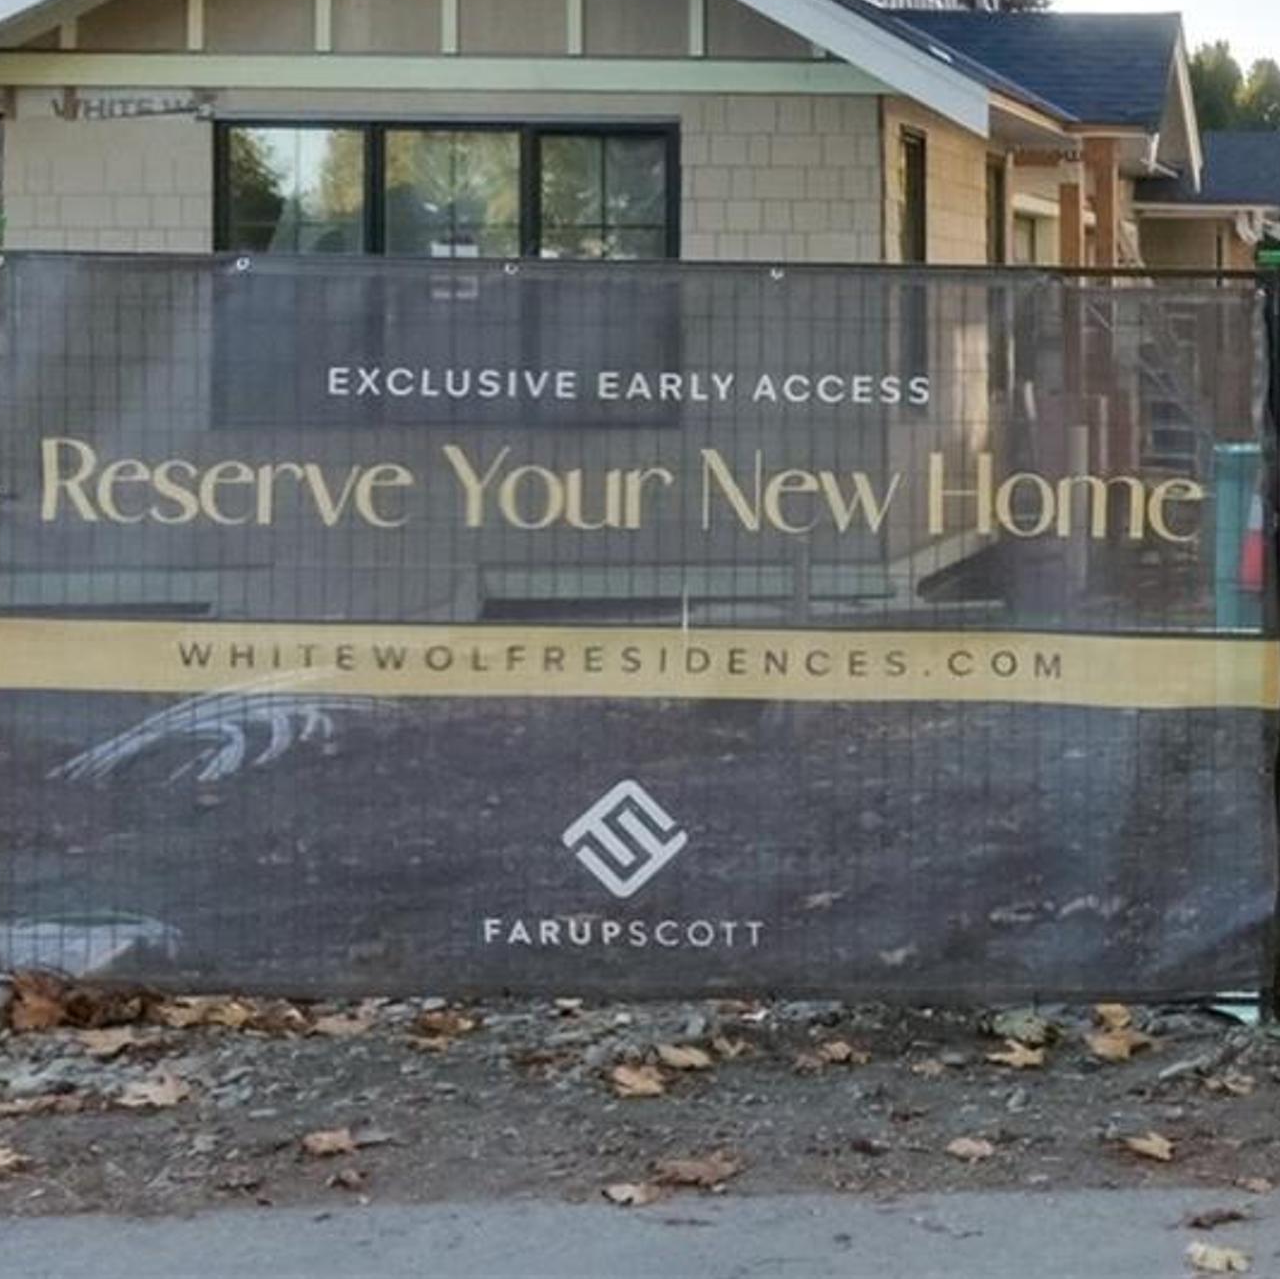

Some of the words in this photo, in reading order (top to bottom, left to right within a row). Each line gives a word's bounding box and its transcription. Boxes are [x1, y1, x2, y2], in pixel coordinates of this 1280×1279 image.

[327, 366, 577, 399] EXCLUSIVE
[597, 371, 735, 402] EARLY
[752, 373, 931, 405] ACCESS
[40, 436, 414, 525] Reserve
[443, 444, 673, 530] Your
[701, 448, 904, 535] New
[928, 451, 1206, 543] Home
[177, 640, 1067, 679] WHITEWOLFRESIDENCES.COM
[483, 917, 763, 948] FARUPSCOTT
